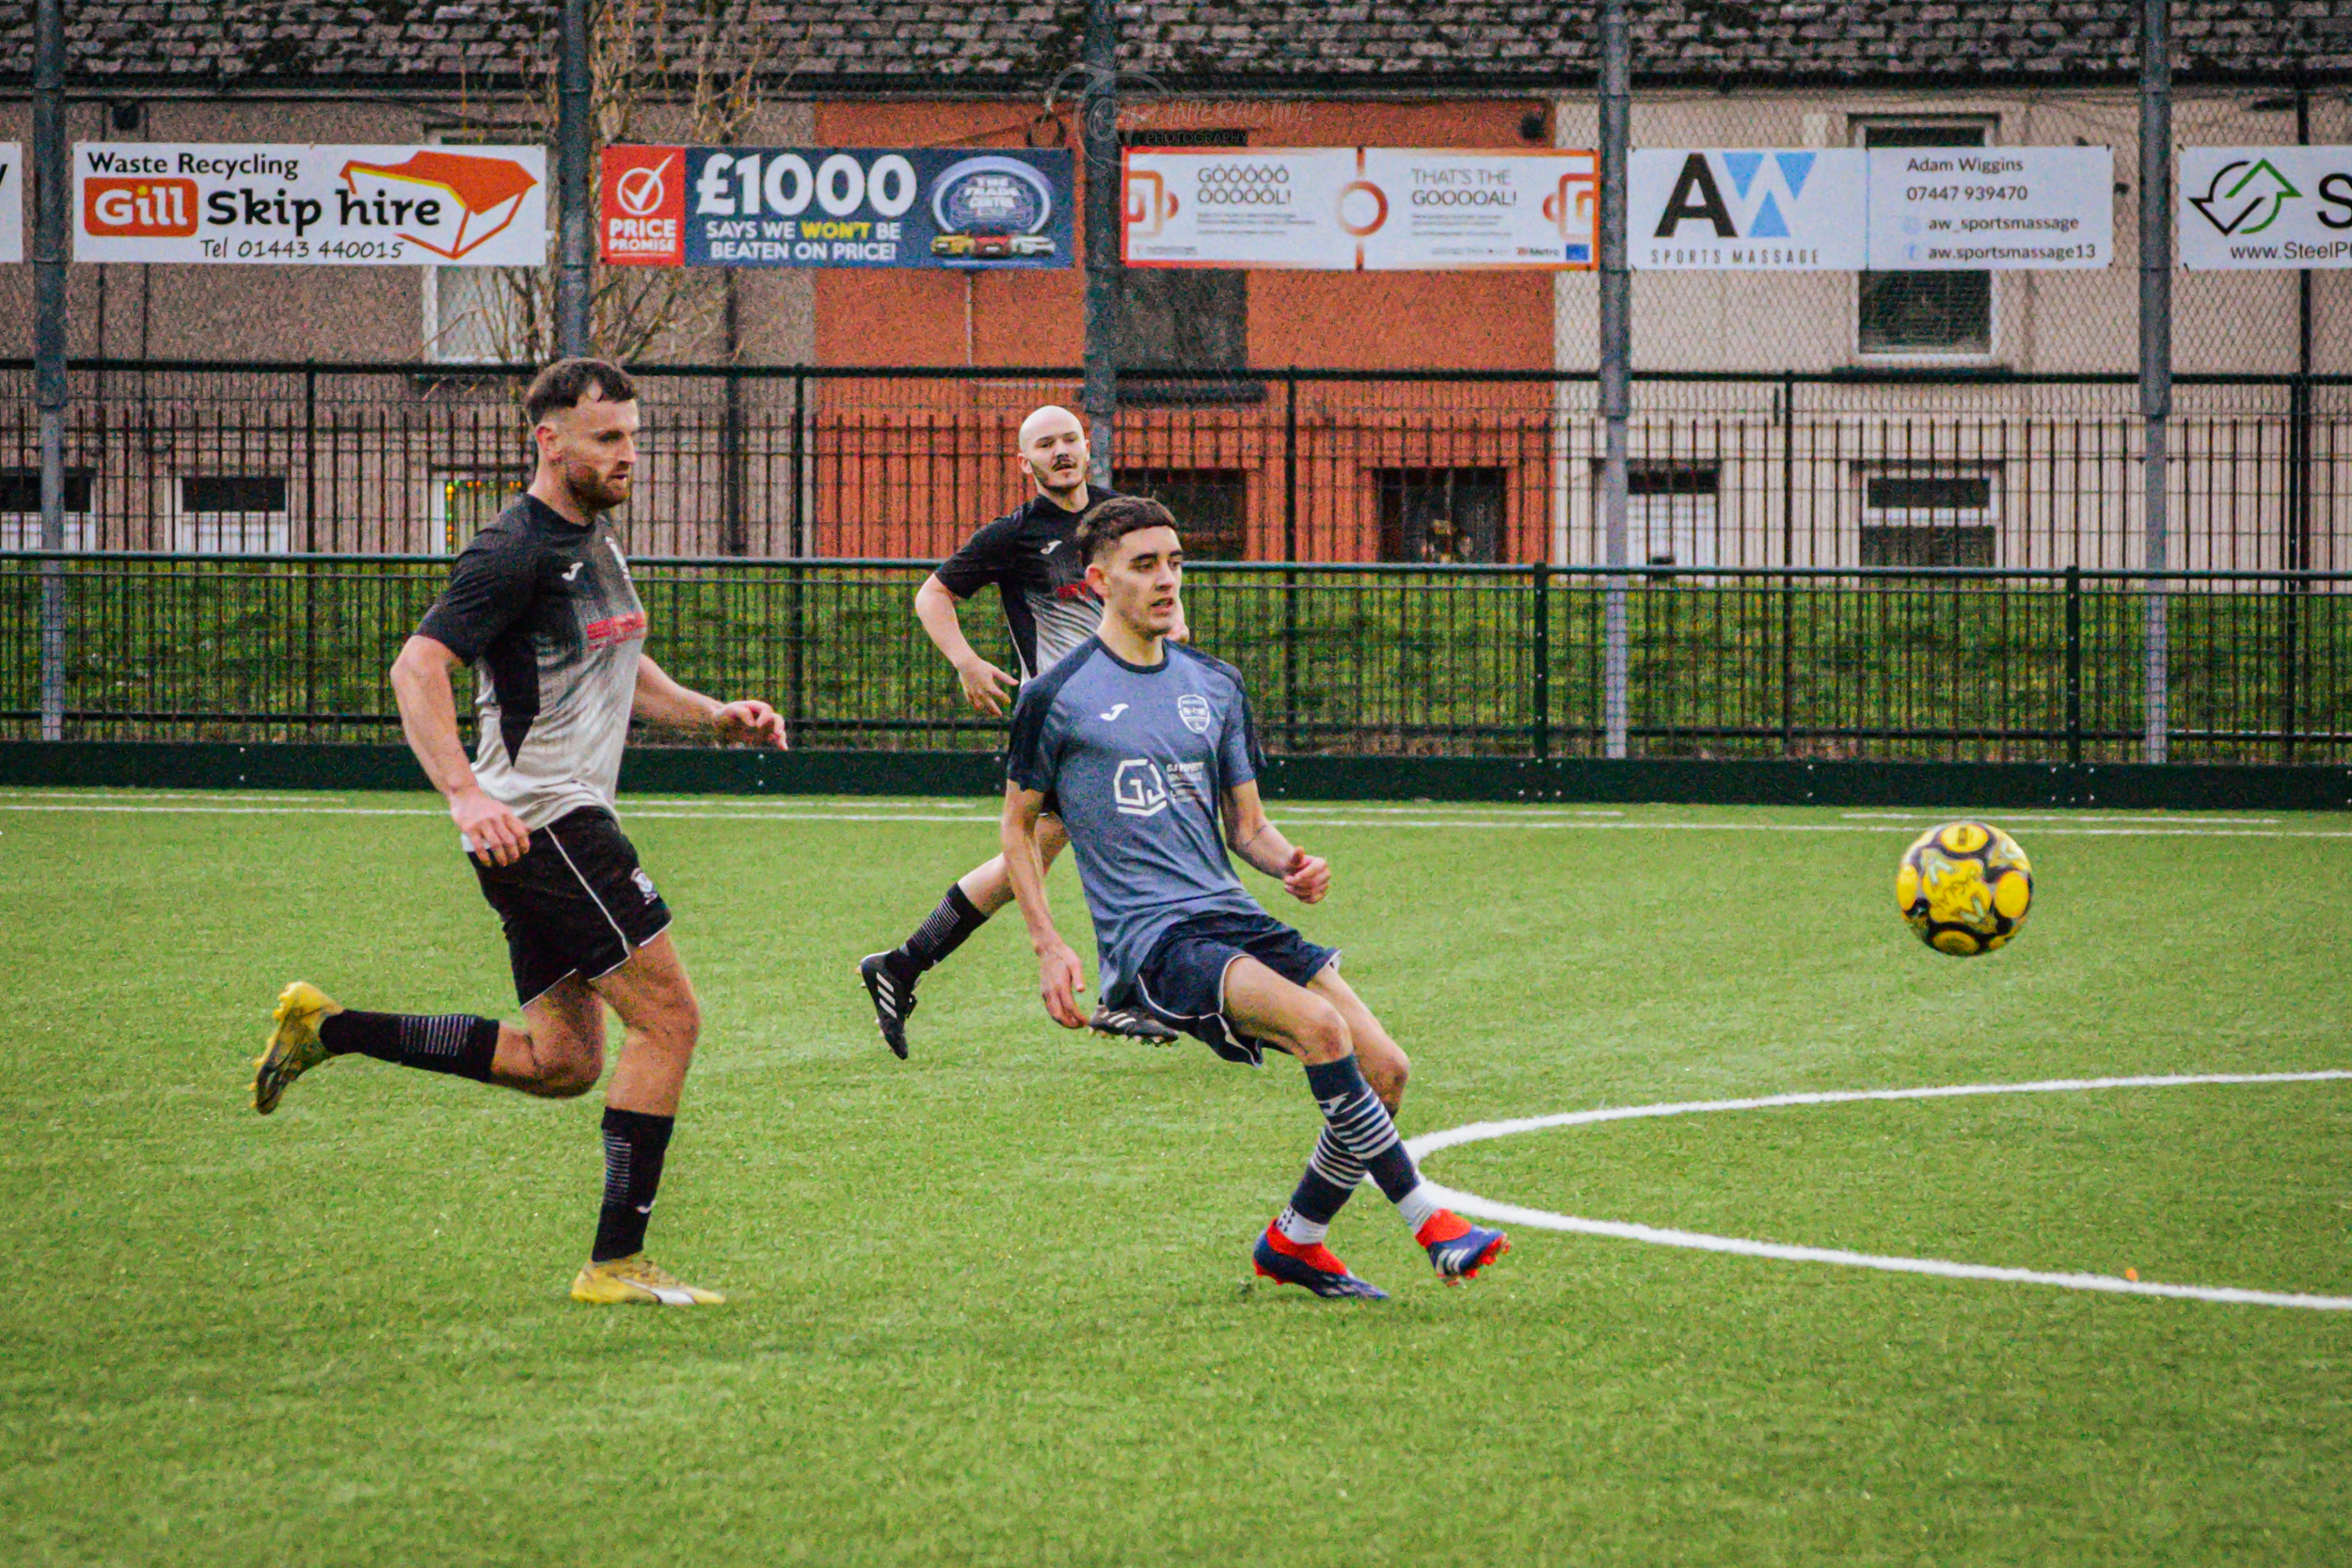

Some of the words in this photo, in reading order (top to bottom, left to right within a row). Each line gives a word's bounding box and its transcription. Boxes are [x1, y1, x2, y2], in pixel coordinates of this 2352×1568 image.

[87, 151, 168, 173] Waste
[177, 152, 299, 181] Recycling
[1907, 158, 1954, 172] Adam
[1959, 158, 2024, 174] Wiggins
[696, 152, 918, 217] £1000
[1476, 169, 1513, 185] THE
[1411, 189, 1518, 206] GOOOOAL!
[1653, 152, 1818, 238] AW
[1906, 186, 1959, 200] 07447
[1964, 186, 2028, 201] 939470
[96, 185, 188, 226] Gill
[207, 188, 322, 237] Skip
[335, 188, 441, 226] hire
[609, 218, 676, 238] PRICE
[707, 221, 757, 239] SAYS
[762, 221, 797, 239] WE
[801, 221, 871, 240] WON'T
[876, 222, 902, 240] BE
[1929, 217, 2079, 233] aw_sportsmassage
[200, 237, 229, 258] Tel
[237, 239, 310, 259] 01443
[318, 240, 405, 259] 440015
[609, 238, 676, 252] PROMISE
[710, 242, 790, 260] BEATEN
[795, 242, 828, 261] ON
[833, 242, 898, 261] PRICE!
[1929, 244, 2096, 261] aw.sportsmassage13
[1652, 248, 1722, 264] SPORTS
[1732, 248, 1820, 264] MASSAGE
